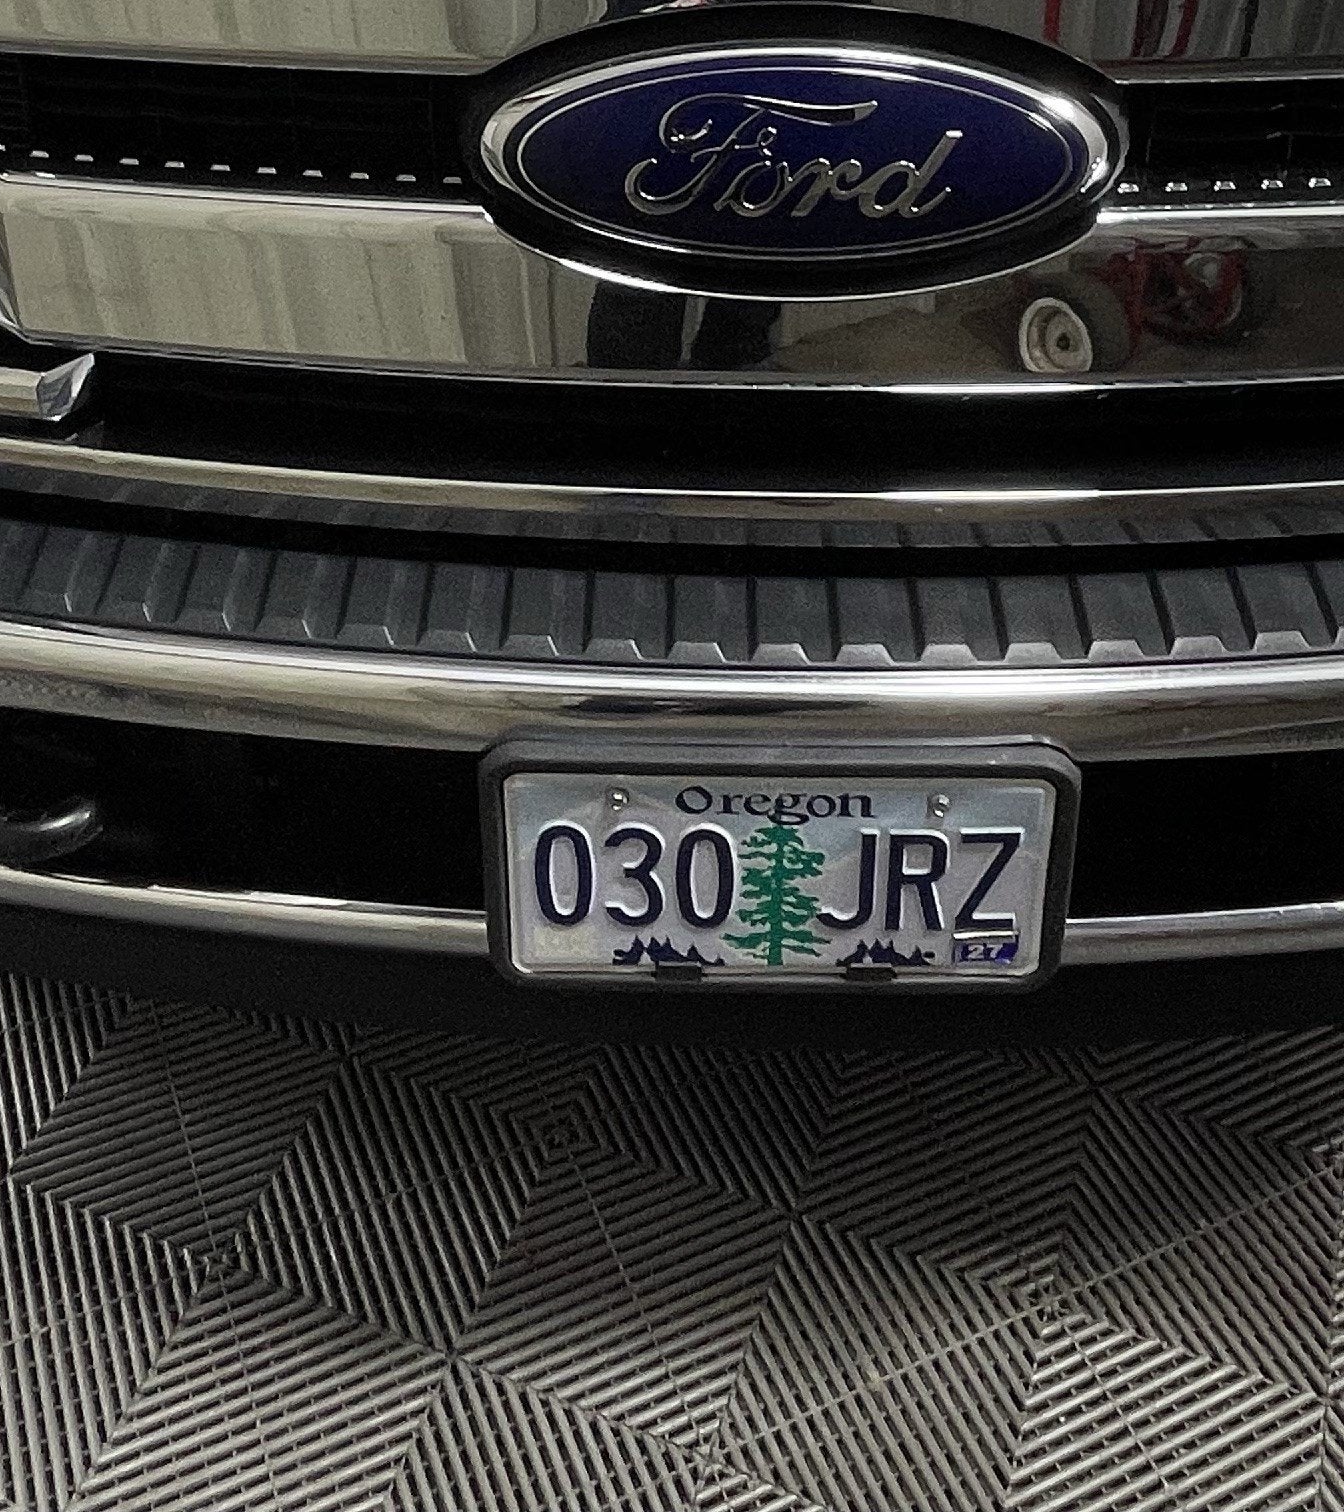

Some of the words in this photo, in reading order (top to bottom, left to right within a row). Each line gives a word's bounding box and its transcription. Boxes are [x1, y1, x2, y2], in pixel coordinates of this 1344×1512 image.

[623, 92, 963, 218] Ford
[674, 785, 876, 825] Oregon
[533, 822, 738, 929] 030
[815, 826, 1025, 931] JRZ
